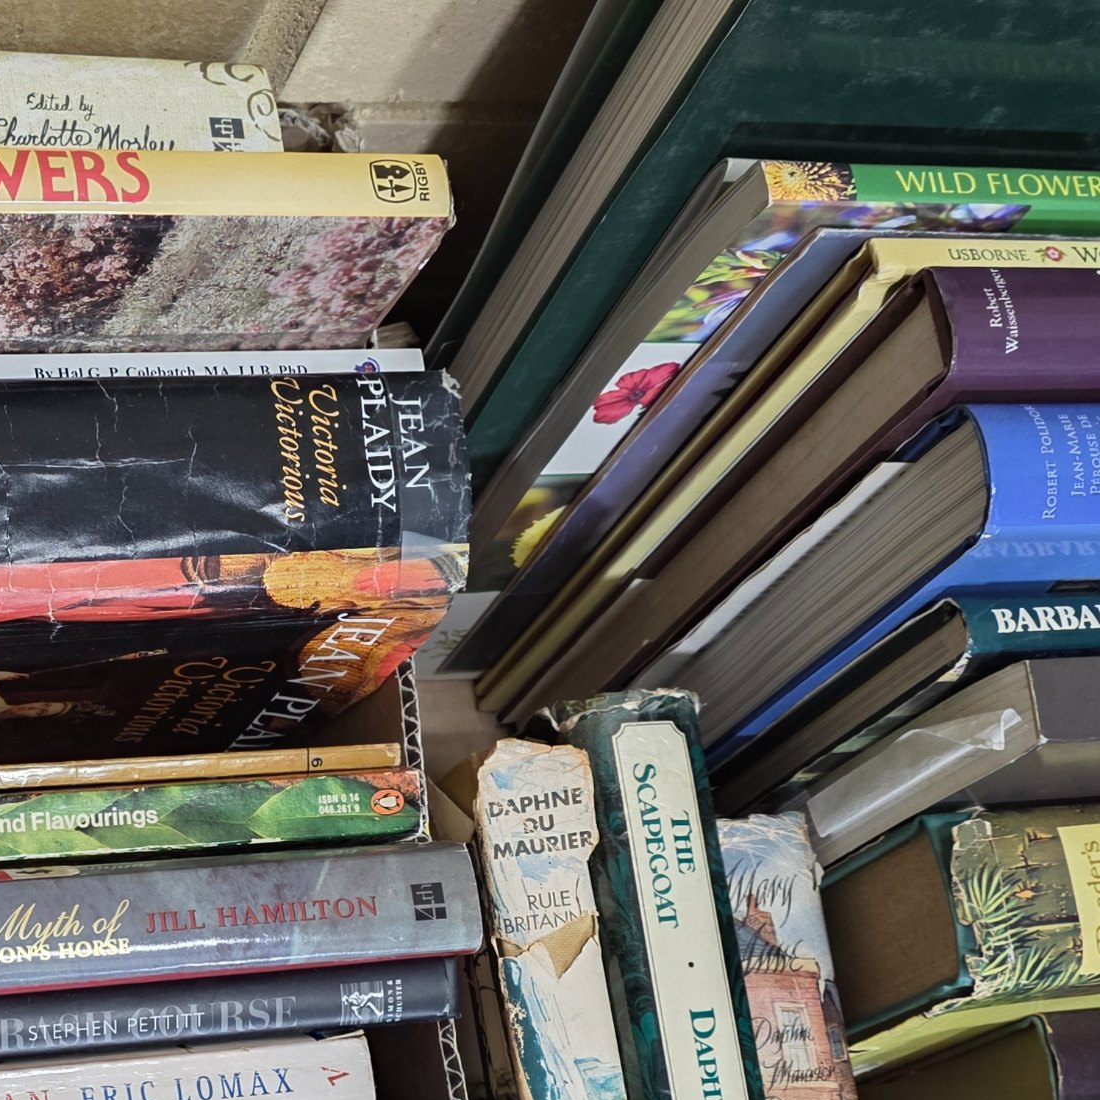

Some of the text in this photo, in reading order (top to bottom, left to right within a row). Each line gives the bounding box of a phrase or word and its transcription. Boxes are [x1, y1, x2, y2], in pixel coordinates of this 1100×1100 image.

[26, 92, 97, 121] Edited by
[418, 159, 430, 202] RIGBY
[895, 170, 977, 194] WILD
[948, 248, 1031, 262] USBORNE
[983, 288, 1003, 327] Robert
[125, 366, 196, 377] Colebatch
[1077, 414, 1093, 429] DE
[269, 376, 305, 523] Victorious
[310, 384, 346, 507] Victoria
[356, 377, 397, 513] PLAIDY
[389, 392, 434, 489] JEAN
[1058, 413, 1086, 496] JEAN-MARIE
[1042, 460, 1058, 519] ROBERT
[287, 612, 398, 692] JEAN
[319, 793, 360, 804] ISBN 14
[488, 787, 583, 819] DAPHNE
[30, 806, 159, 834] Flavourings
[523, 815, 555, 833] DU
[493, 829, 593, 860] MAURIER
[633, 763, 679, 930] SCAPEGOAT
[671, 811, 697, 874] THE
[527, 890, 571, 910] RULE
[92, 899, 130, 952] of
[145, 909, 205, 934] JILL
[216, 895, 378, 928] HAMILTON
[58, 937, 130, 959] HORSE
[29, 1012, 205, 1041] STEPHEN PETTITT
